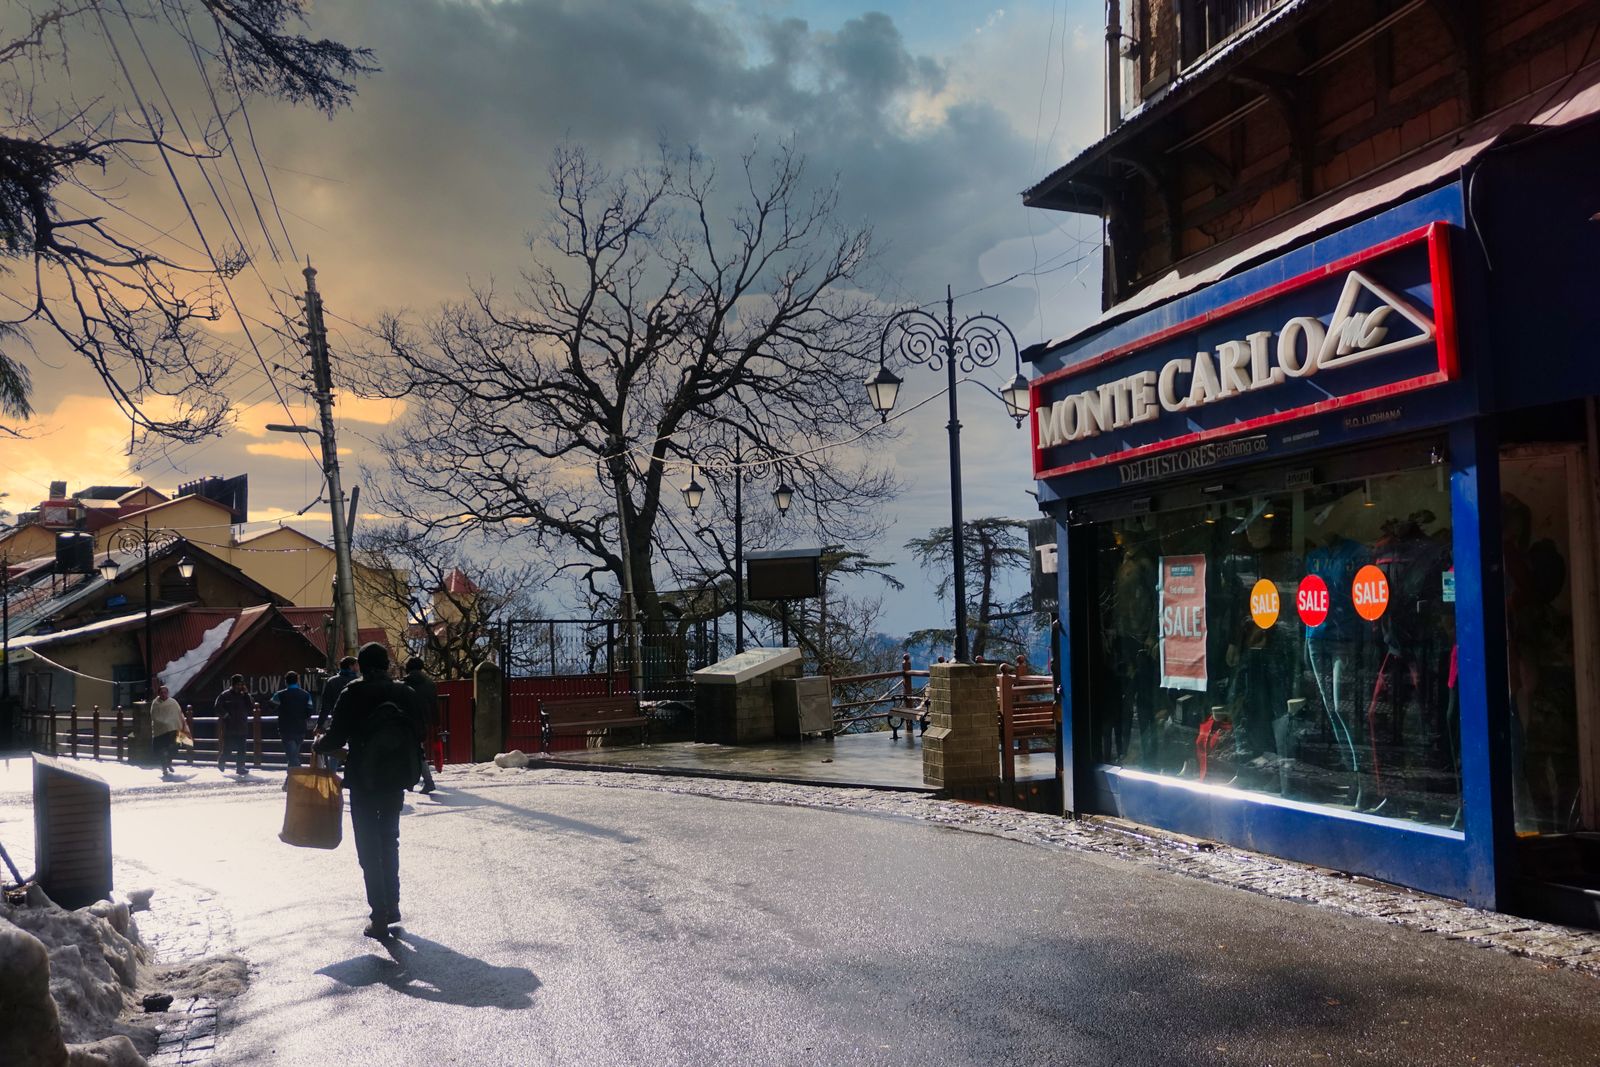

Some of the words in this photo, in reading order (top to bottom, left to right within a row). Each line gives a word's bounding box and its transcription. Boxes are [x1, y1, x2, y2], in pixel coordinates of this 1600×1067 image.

[1036, 370, 1159, 450] MONTE
[1157, 316, 1328, 412] CARLO
[1361, 409, 1401, 425] LUDHIANA
[1216, 440, 1251, 459] clothing
[1119, 456, 1160, 483] DELHI
[1160, 443, 1217, 475] STORES
[1252, 592, 1279, 615] SALE
[1298, 589, 1328, 612] SALE
[1354, 580, 1387, 605] SALE
[1163, 605, 1202, 638] SALE
